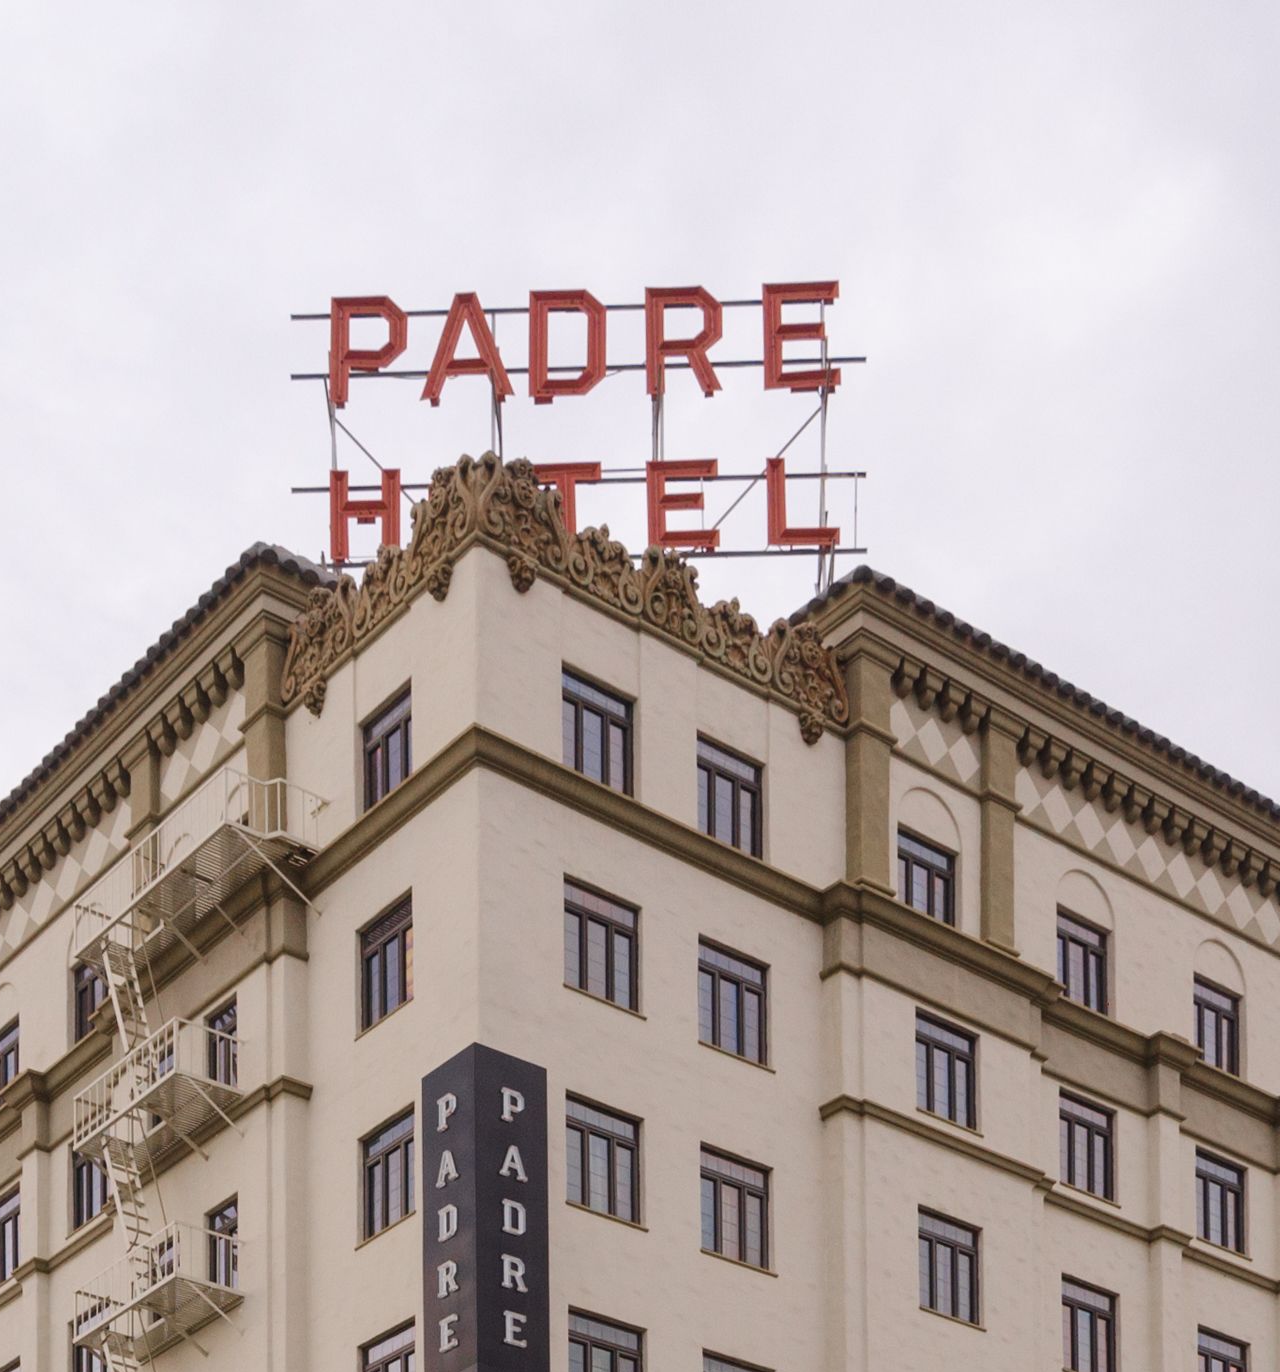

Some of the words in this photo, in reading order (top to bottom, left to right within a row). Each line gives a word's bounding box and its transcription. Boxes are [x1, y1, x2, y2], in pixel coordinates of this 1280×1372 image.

[328, 281, 841, 407] PADRE
[329, 458, 841, 563] HTEL
[435, 1091, 460, 1354] PADRE
[498, 1086, 528, 1349] PADRE
